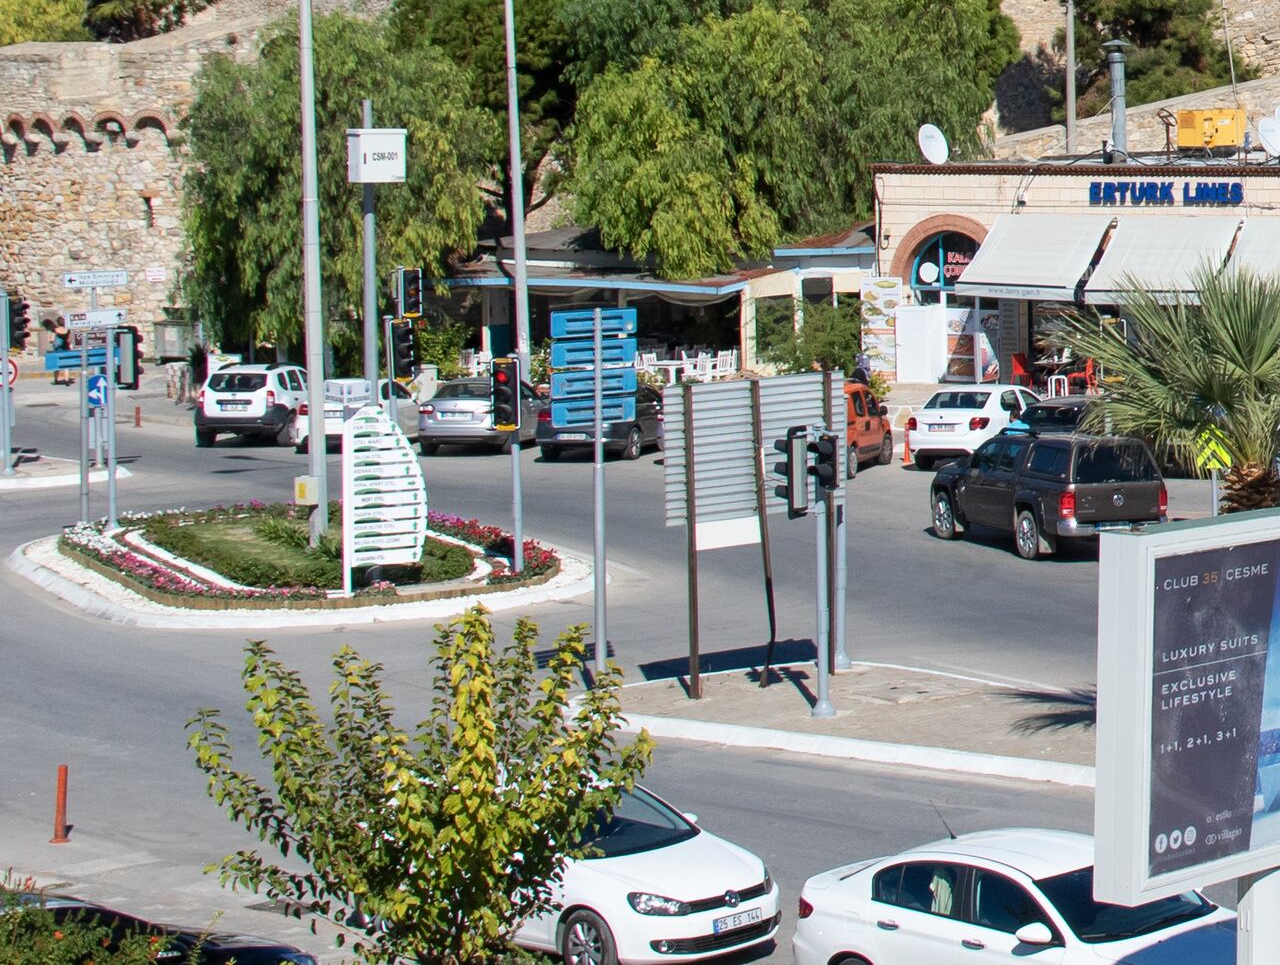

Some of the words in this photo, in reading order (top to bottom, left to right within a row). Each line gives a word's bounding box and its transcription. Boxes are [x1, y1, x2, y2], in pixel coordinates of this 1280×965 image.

[372, 151, 399, 161] CSM-001
[1182, 181, 1245, 205] LINES
[1163, 575, 1199, 590] CLUB
[1201, 571, 1219, 585] 35
[1225, 563, 1269, 581] CESME
[1161, 642, 1216, 663] LUXURY
[1220, 634, 1259, 651] SUITS
[1161, 670, 1237, 695] EXCLUSIVE
[1161, 686, 1233, 710] LIFESTYLE
[1160, 741, 1183, 755] 1+1,
[1186, 734, 1212, 748] 2+1,
[1216, 727, 1237, 742] 3+1
[733, 915, 742, 926] ES
[747, 911, 760, 922] 144
